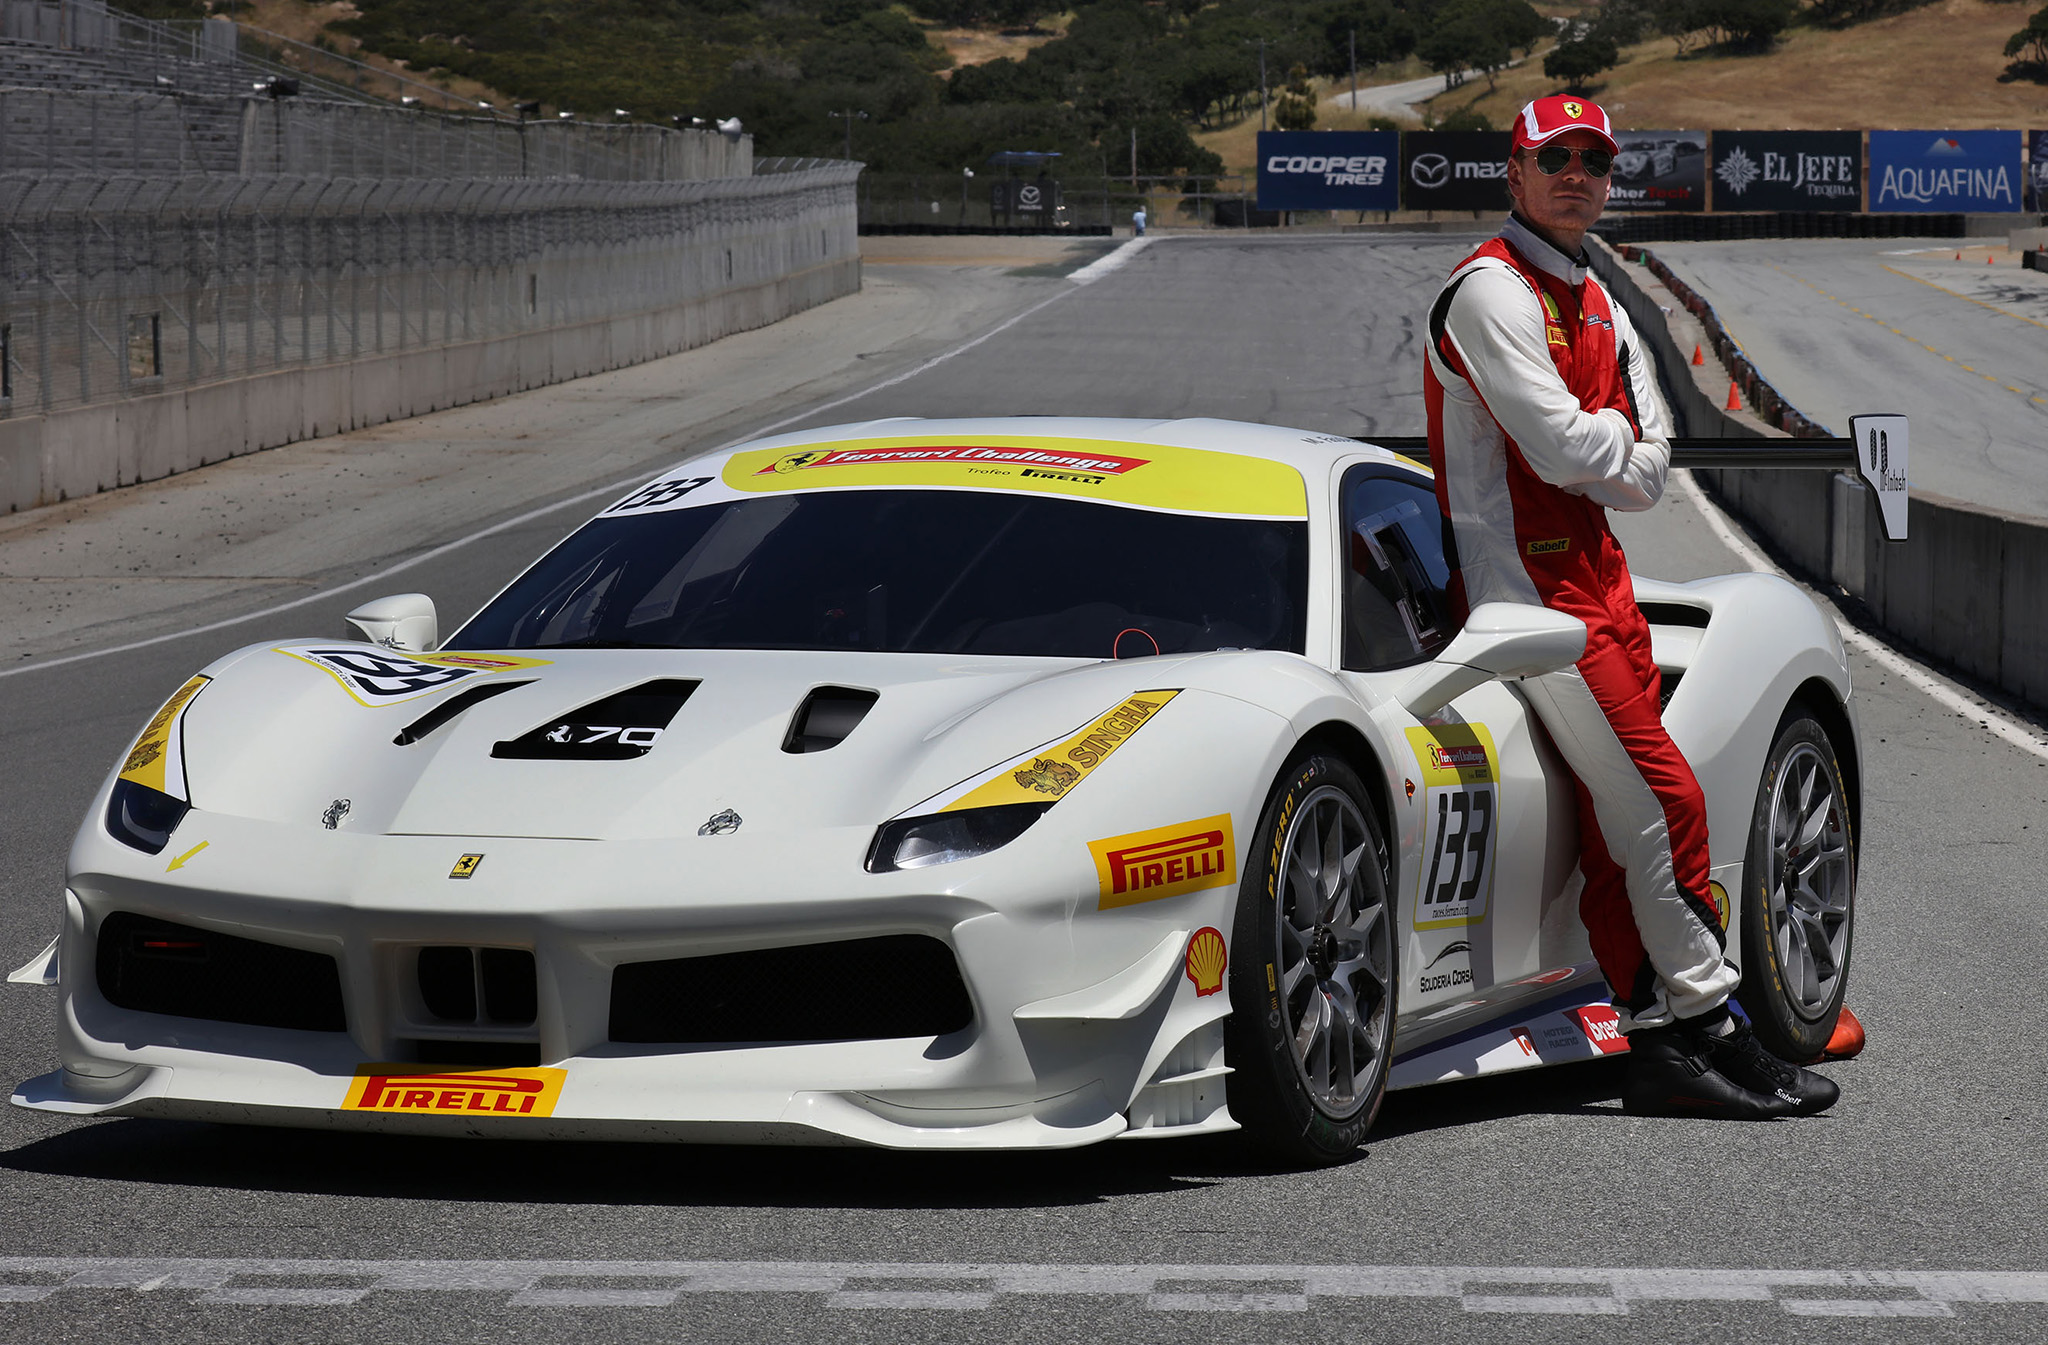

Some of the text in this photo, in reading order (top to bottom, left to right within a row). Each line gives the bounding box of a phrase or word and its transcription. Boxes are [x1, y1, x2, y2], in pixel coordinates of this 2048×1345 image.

[1267, 156, 1387, 173] COOPER
[1455, 161, 1508, 179] maz
[1763, 152, 1852, 188] EL JEFE
[1324, 173, 1384, 186] TIRES
[1807, 184, 1855, 198] TEQUILA
[1878, 165, 2013, 204] AQUAFINA
[1609, 186, 1690, 199] therTech
[826, 447, 1122, 470] Ferrari Challenge
[967, 467, 1106, 485] Trofeo PIRELLI
[604, 476, 716, 514] 133
[1531, 539, 1568, 553] Sabelt
[307, 650, 478, 696] 133
[1068, 698, 1160, 769] SINGHA
[1270, 792, 1294, 875] ZERO
[1424, 790, 1492, 905] 133
[1106, 829, 1225, 895] PIRELLI
[1420, 968, 1475, 993] SCUDERIA CORSA
[1543, 1026, 1574, 1038] MOTEGI
[1548, 1037, 1579, 1049] RACING
[357, 1074, 545, 1114] PIRELLI
[1774, 1088, 1802, 1106] Sabelt
